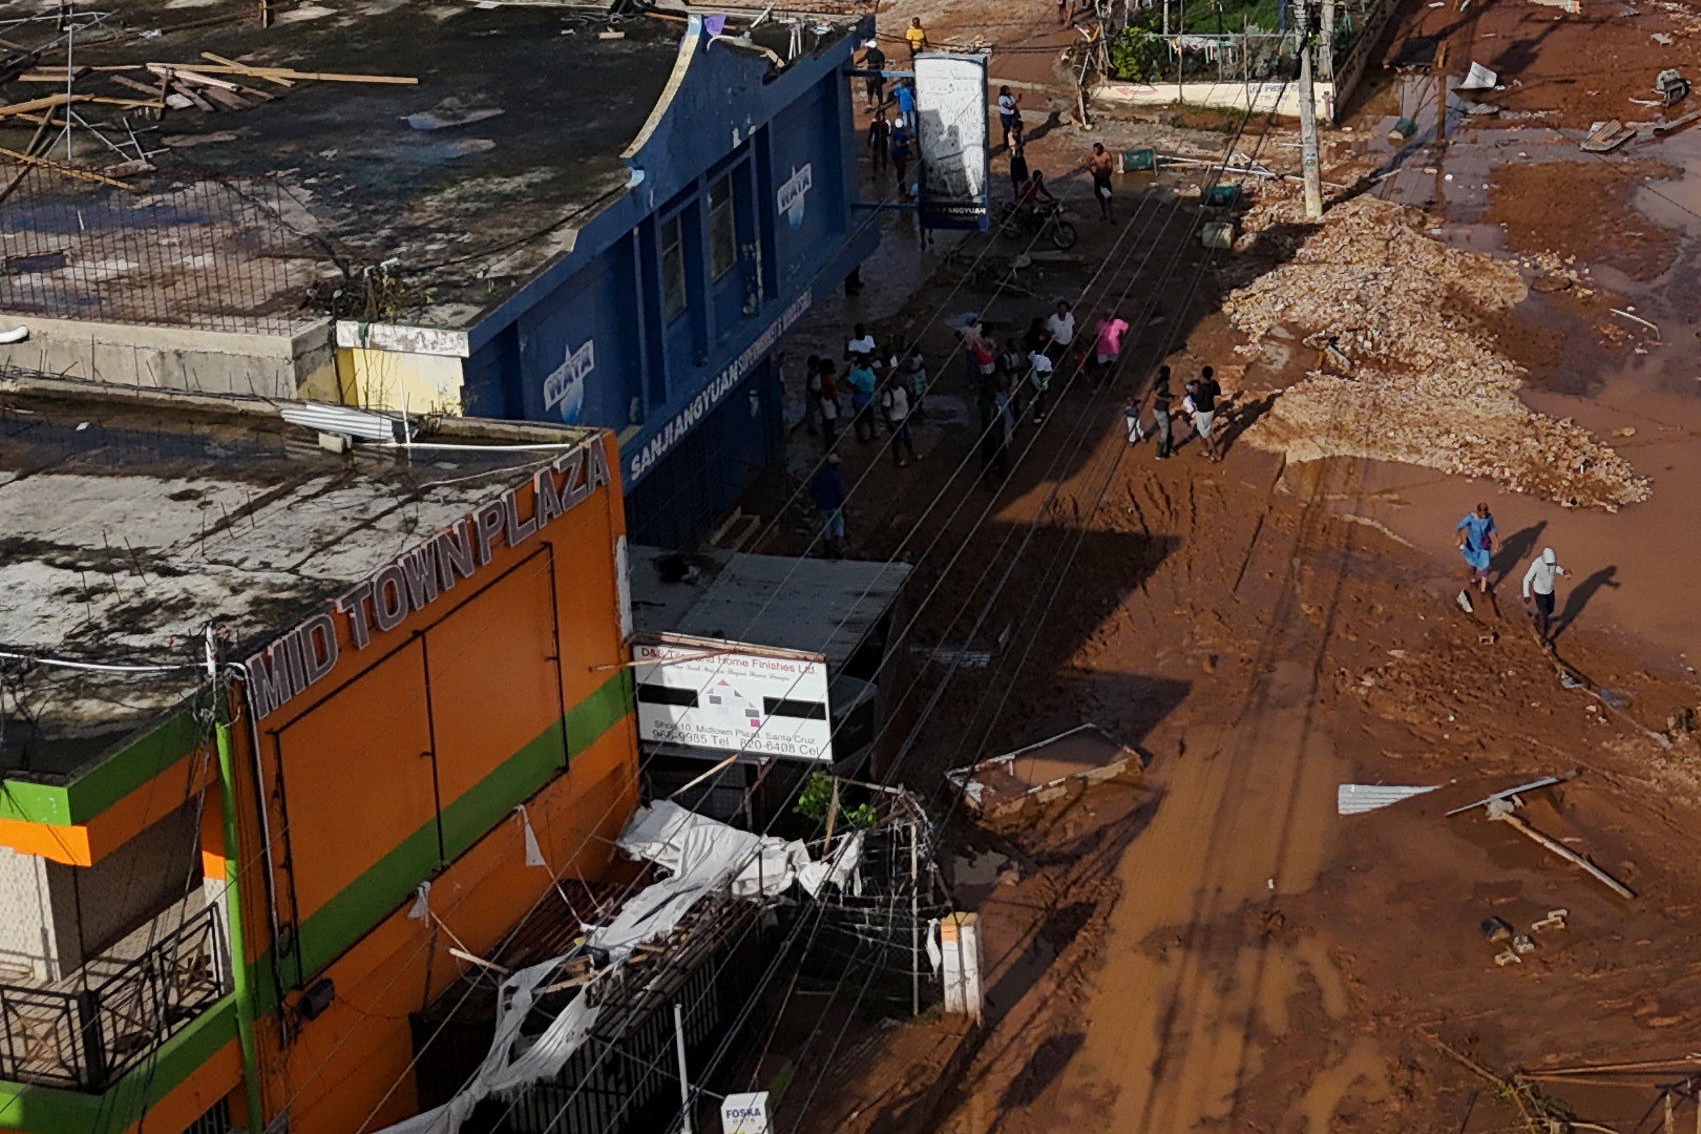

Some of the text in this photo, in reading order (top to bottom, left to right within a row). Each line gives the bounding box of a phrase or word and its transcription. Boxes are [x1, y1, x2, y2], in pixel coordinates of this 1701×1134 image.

[631, 359, 738, 481] SANJIANGYUAN
[246, 433, 611, 721] MID TOWN PLAZA
[718, 658, 749, 668] Home
[752, 659, 796, 673] Finishes
[654, 720, 678, 731] Shop
[765, 732, 793, 742] Santa
[794, 735, 816, 744] Cruz
[711, 735, 730, 746] Tel
[799, 744, 820, 756] Cel
[726, 1108, 761, 1119] FOSKA
